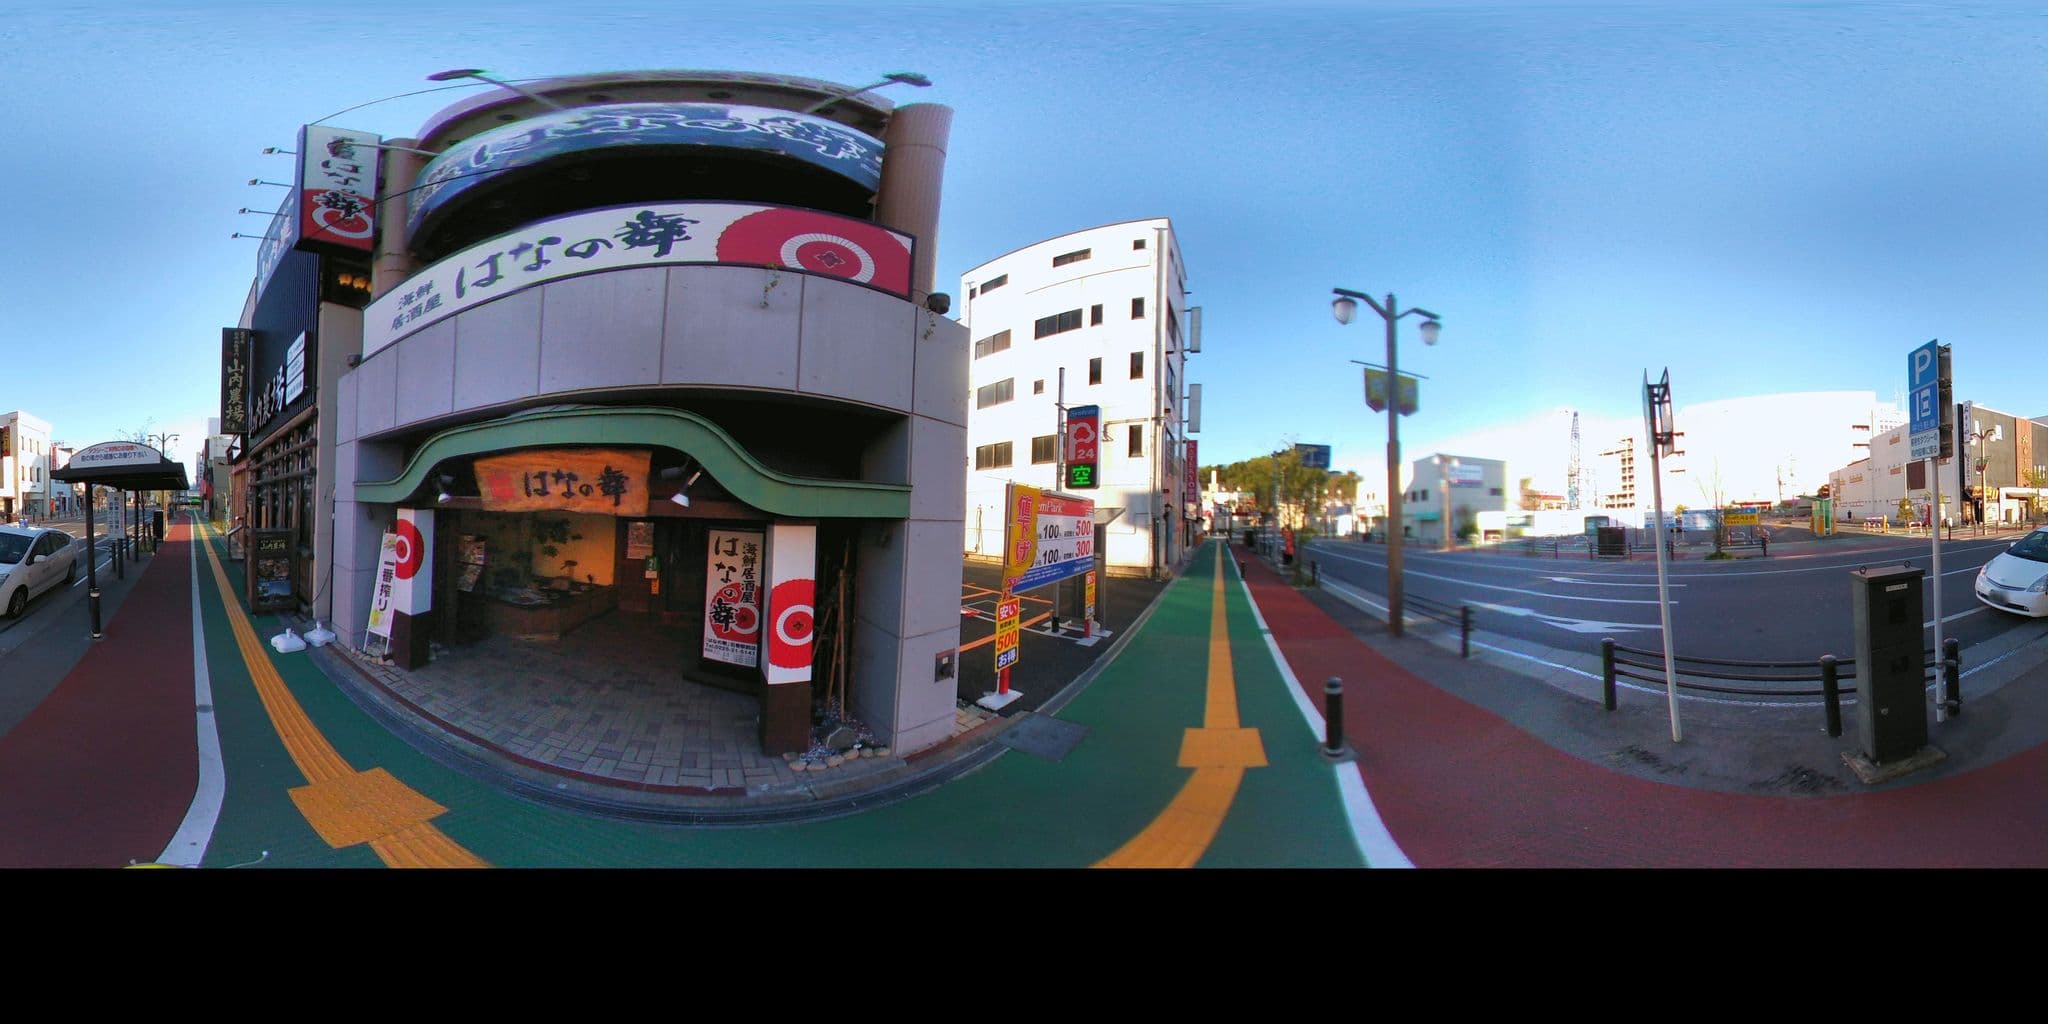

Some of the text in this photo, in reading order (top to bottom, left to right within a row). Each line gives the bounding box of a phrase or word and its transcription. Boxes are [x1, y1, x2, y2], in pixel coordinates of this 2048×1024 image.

[455, 209, 700, 300] はなの舞
[398, 280, 434, 310] 海鮮
[390, 293, 443, 333] 居酒屋
[1914, 349, 1931, 385] P
[226, 358, 245, 422] 山内農場
[1077, 448, 1095, 459] 24
[523, 465, 630, 507] はなの舞
[1071, 465, 1091, 485] 空
[1016, 494, 1033, 562] 値下げ
[1043, 525, 1060, 539] 100
[1075, 520, 1091, 536] 500
[1042, 549, 1059, 565] 100
[1075, 541, 1091, 557] 300
[379, 561, 395, 612] 一番搾り
[709, 536, 739, 632] はなの舞
[740, 542, 758, 604] 海鮮居酒屋
[1000, 604, 1017, 620] 安い
[997, 630, 1017, 652] 500
[998, 648, 1016, 667] お得
